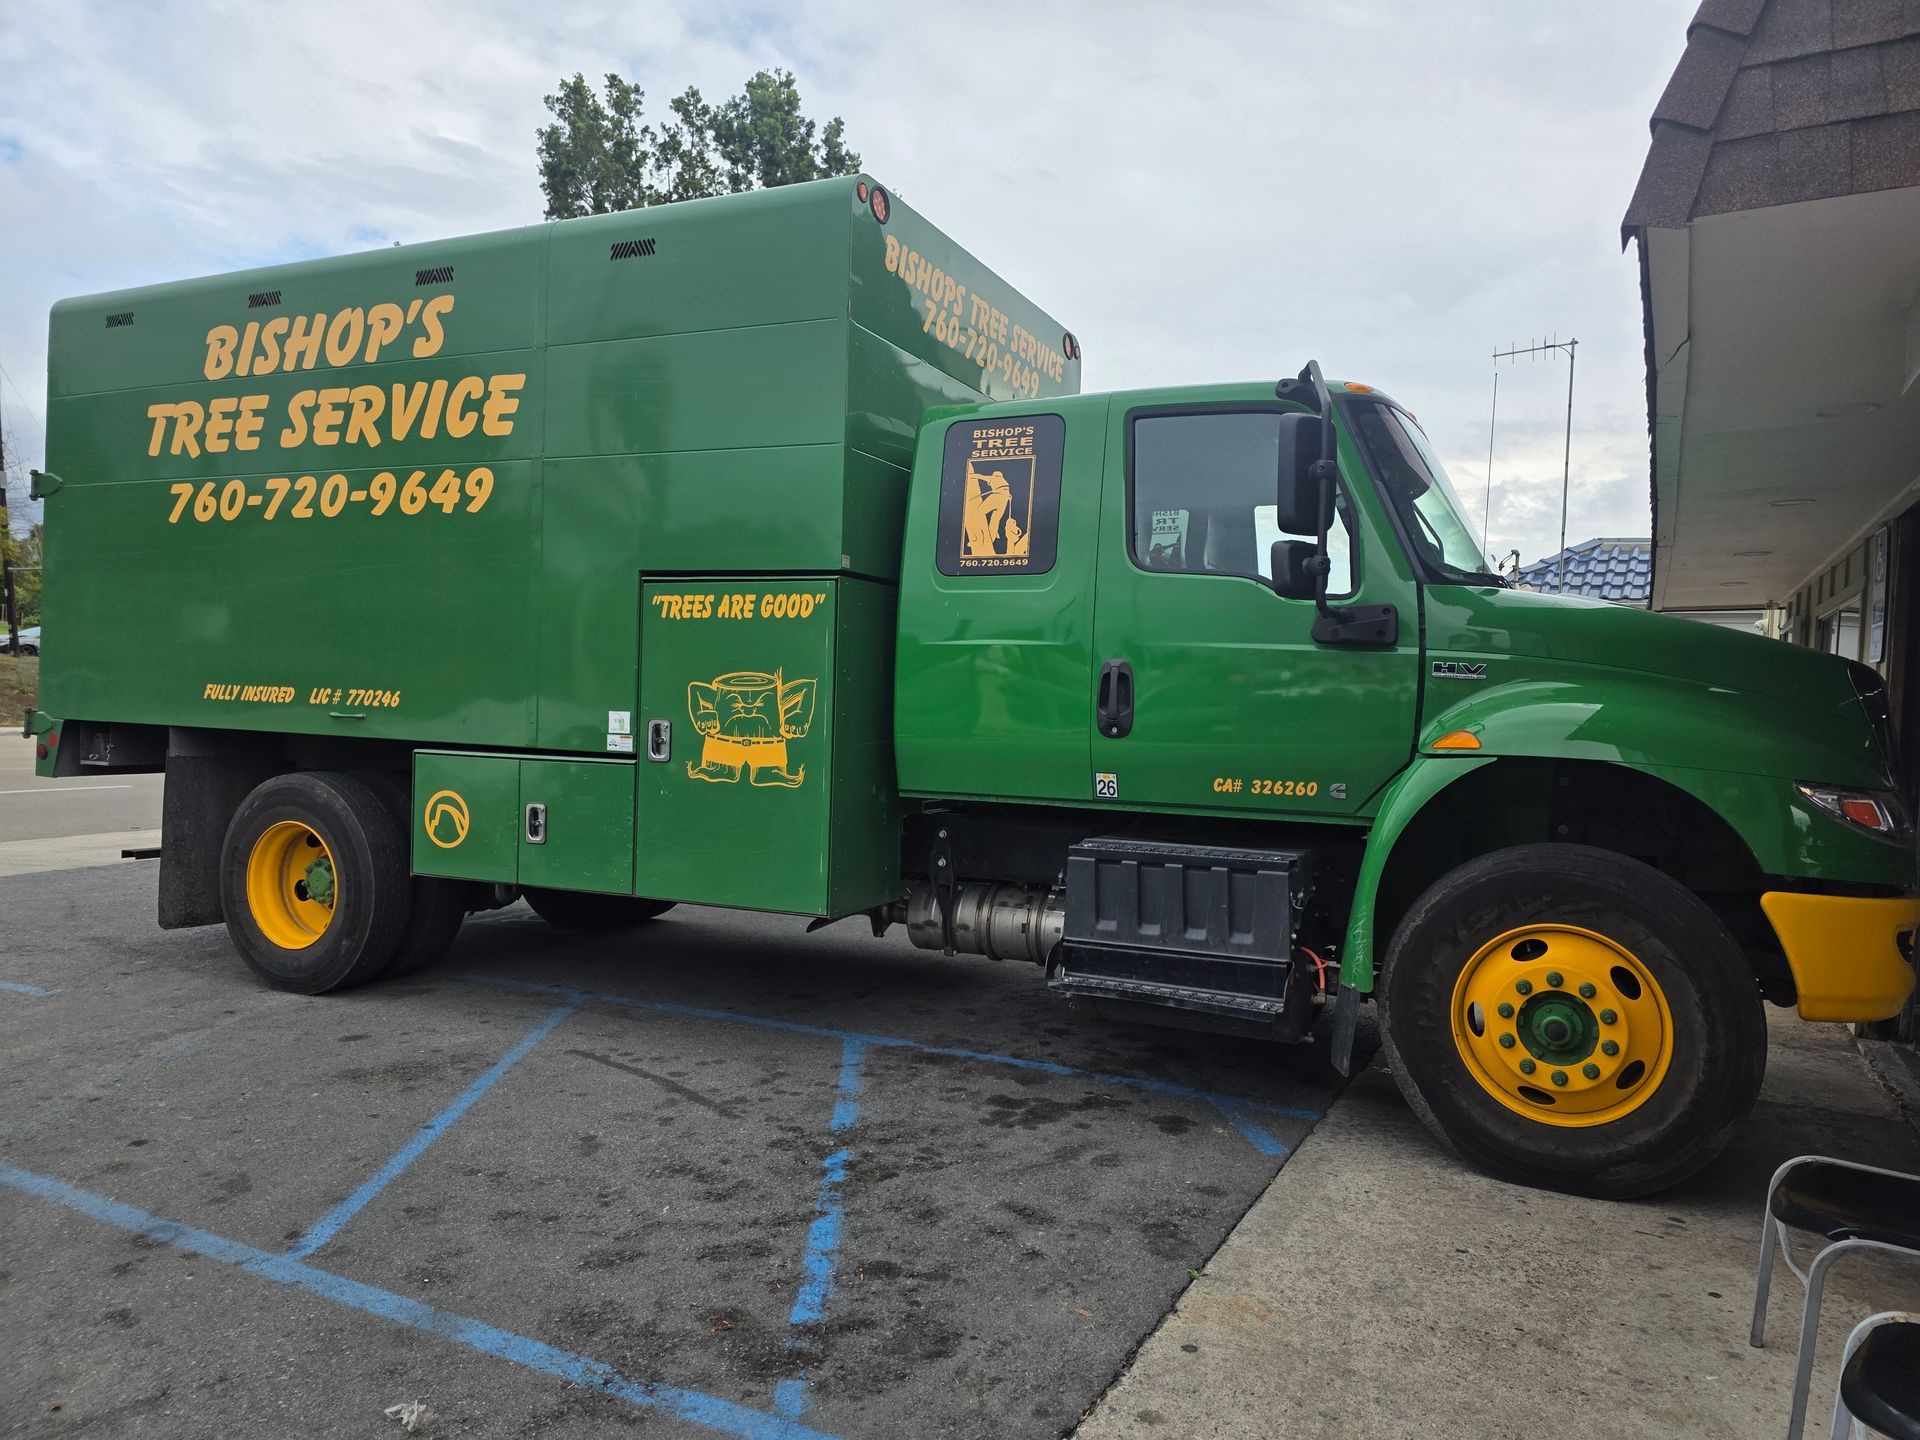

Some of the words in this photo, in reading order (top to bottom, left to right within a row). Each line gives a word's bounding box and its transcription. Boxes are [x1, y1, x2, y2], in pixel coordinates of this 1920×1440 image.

[203, 295, 455, 381] BISHOP'S
[923, 298, 1040, 399] 760-720-9649
[970, 293, 1009, 345] TREE
[1010, 324, 1064, 384] SERVICE
[147, 394, 270, 459] TREE
[280, 373, 526, 448] SERVICE
[972, 437, 1033, 449] TREE
[973, 426, 1034, 438] BISHOP'S
[971, 447, 1033, 458] SERVICE
[168, 467, 495, 524] 760-720-9649
[959, 558, 1029, 567] 760.720.9649
[652, 594, 715, 620] "TREES
[717, 594, 757, 620] ARE
[760, 593, 826, 619] GOOD"
[1432, 661, 1487, 675] HV
[203, 684, 241, 701] FULLY
[240, 685, 295, 704] INSURED
[346, 689, 400, 708] 770246
[1098, 779, 1116, 796] 26
[1213, 777, 1243, 793] CA#
[1251, 779, 1318, 797] 326260
